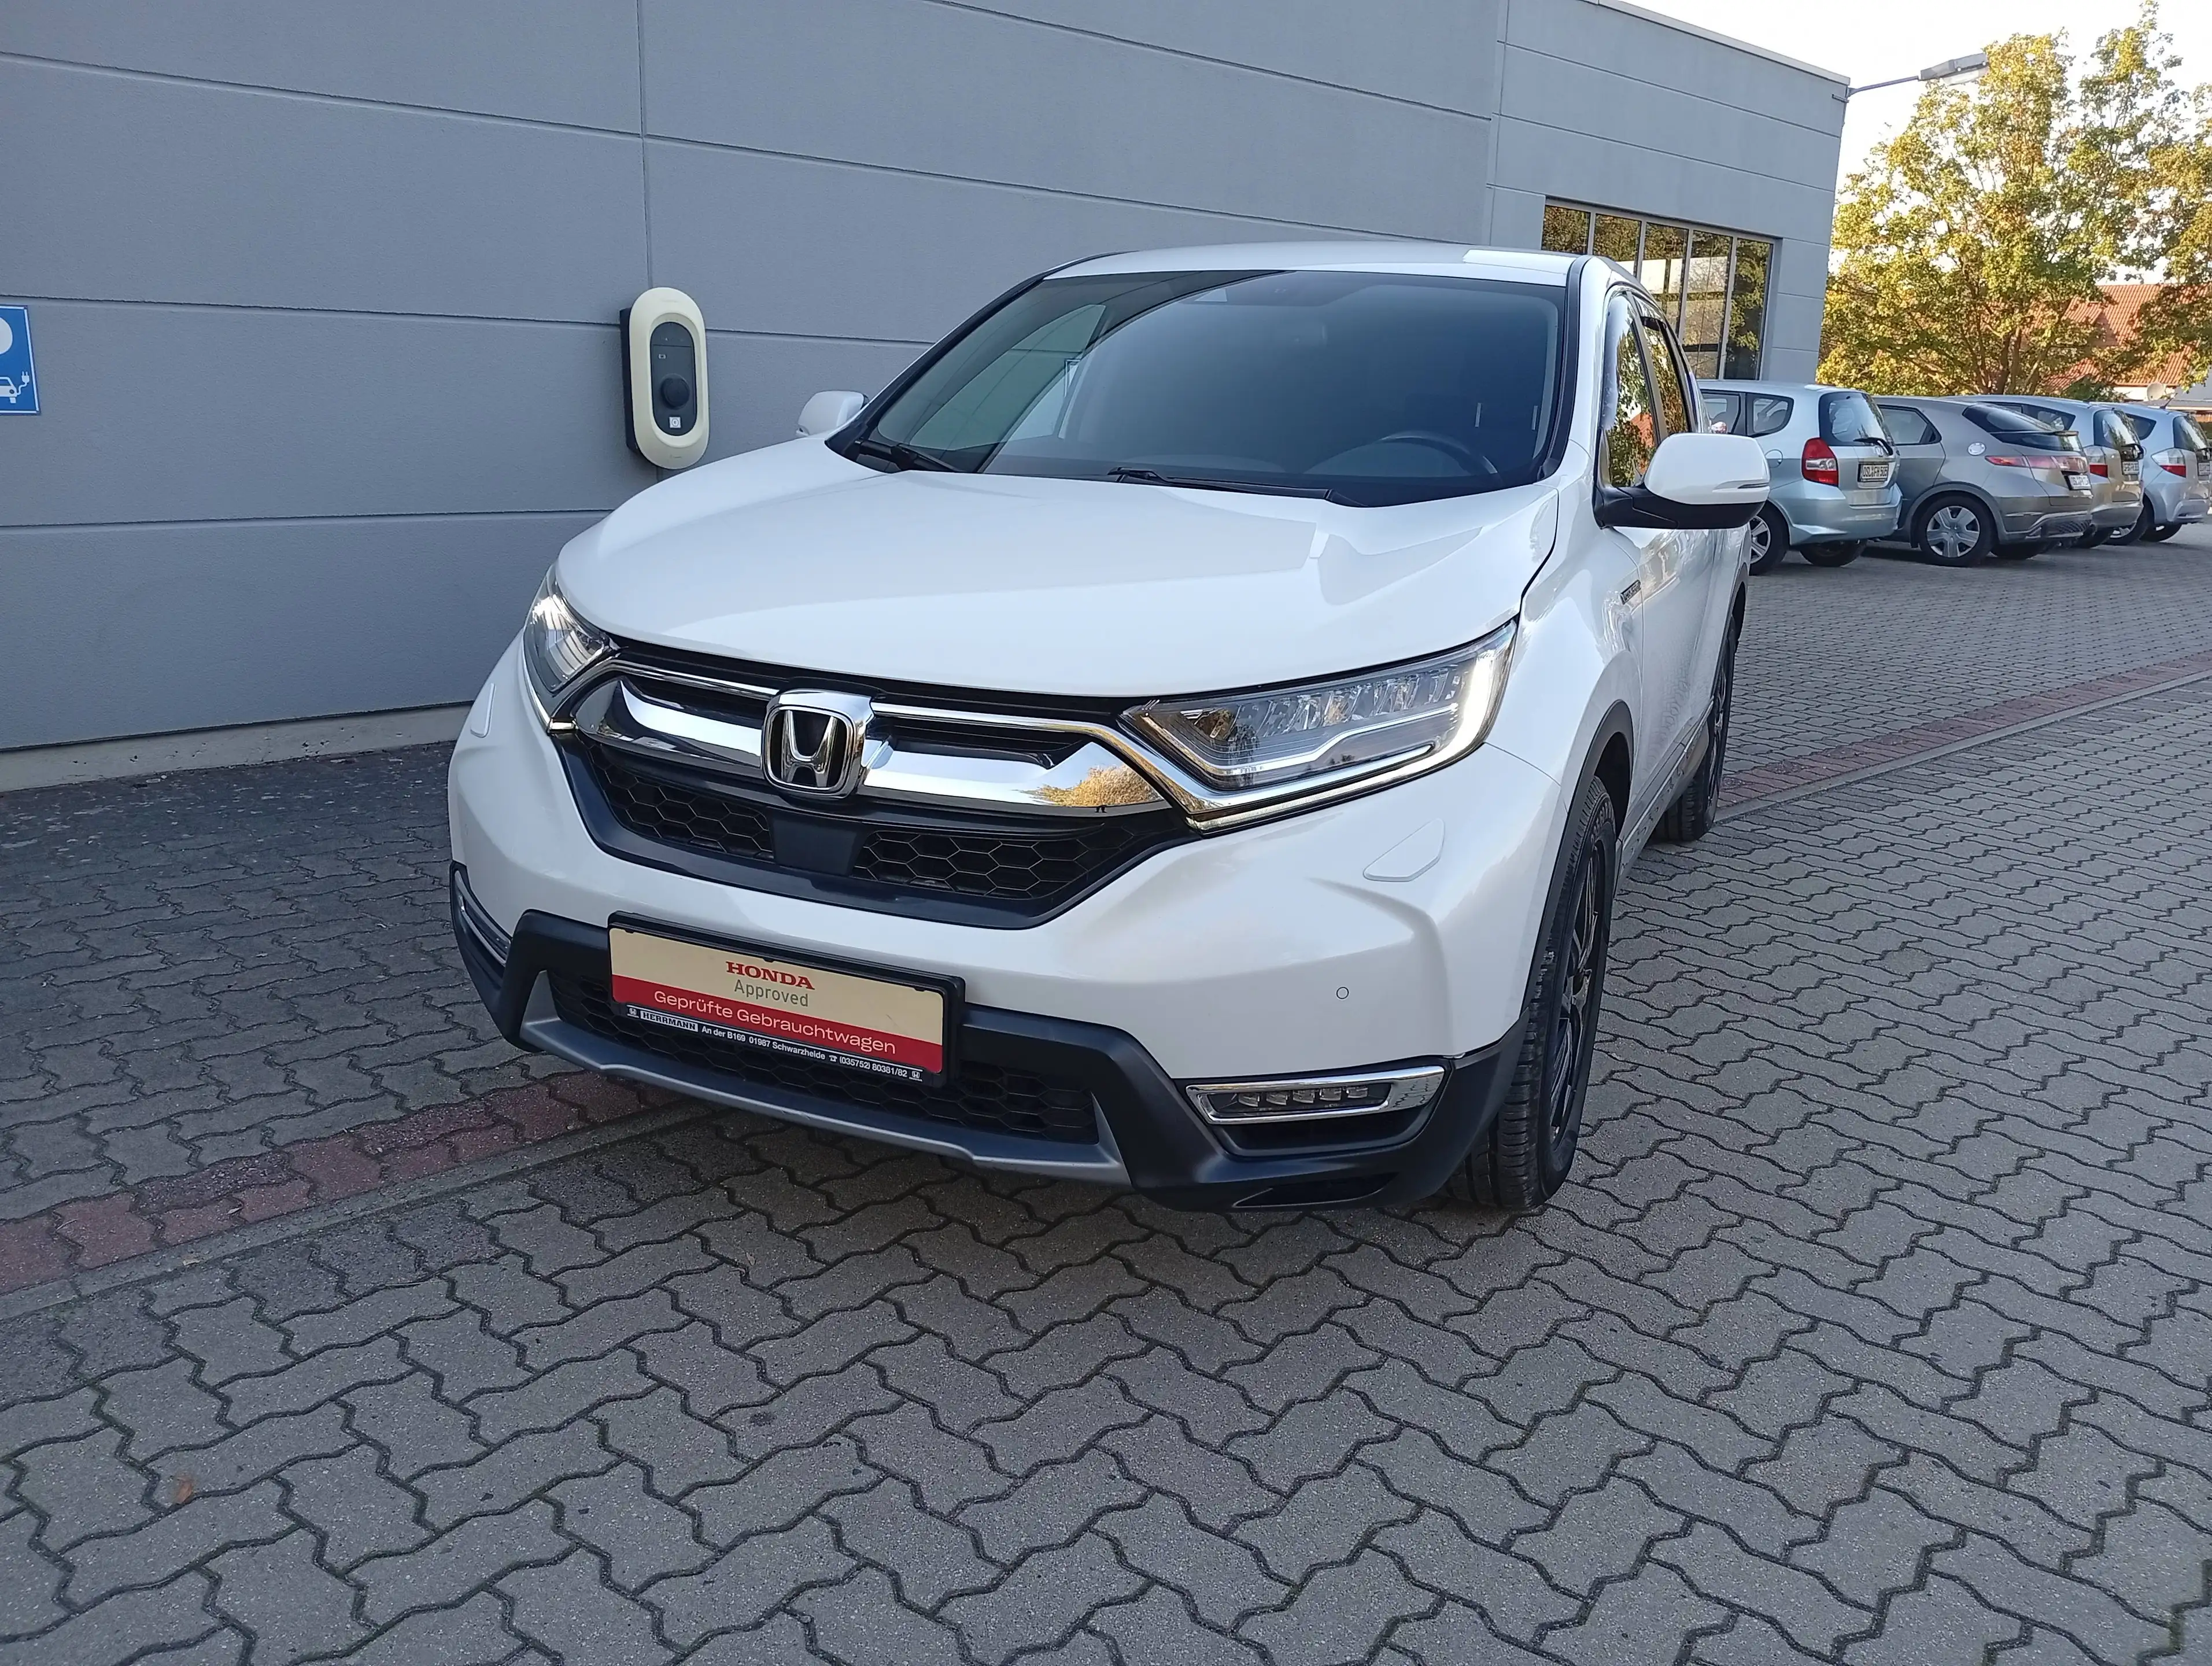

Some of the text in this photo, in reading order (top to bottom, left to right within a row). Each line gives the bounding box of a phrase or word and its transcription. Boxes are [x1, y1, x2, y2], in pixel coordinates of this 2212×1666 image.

[726, 961, 815, 990] HONDA
[734, 979, 808, 1007] Approved
[642, 1011, 907, 1078] HERRMANN An der B169 01987 Schwarzheide (035752) 80381/82
[654, 990, 896, 1055] Geprüfte Gebrauchtwagen
